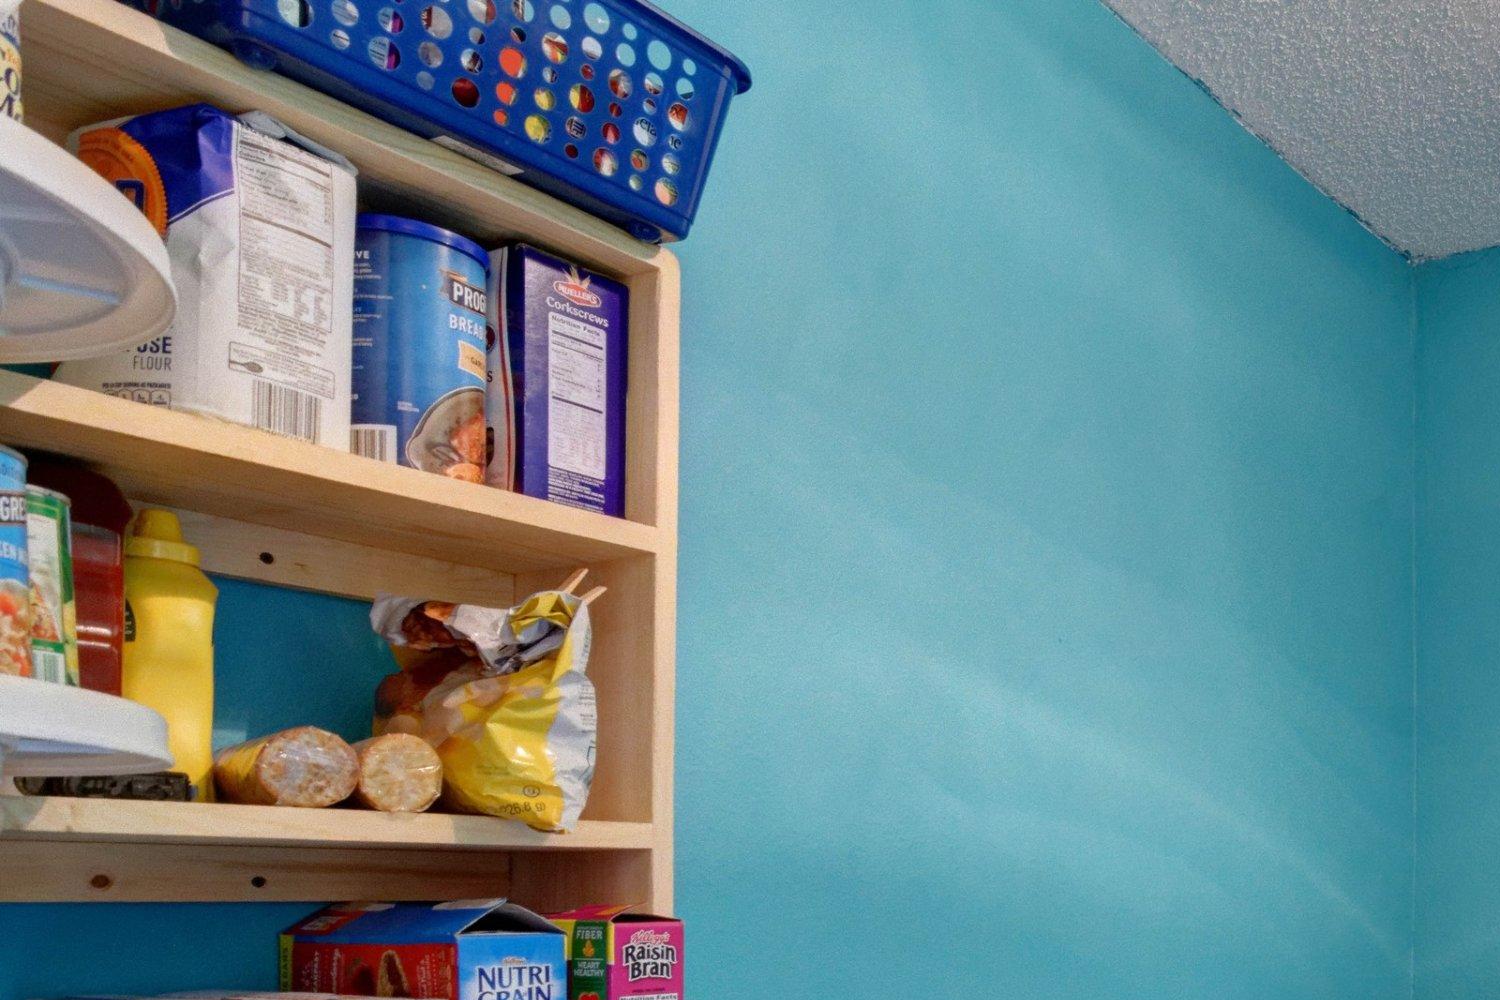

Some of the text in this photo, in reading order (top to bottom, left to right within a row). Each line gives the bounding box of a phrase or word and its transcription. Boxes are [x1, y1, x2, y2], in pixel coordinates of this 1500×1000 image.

[546, 296, 610, 328] Corkscrews
[132, 355, 172, 372] FLOUR
[576, 929, 604, 940] FIBER
[623, 944, 678, 966] Raisin
[573, 969, 605, 978] HEALTHY
[577, 961, 601, 969] HEART
[629, 961, 673, 981] Bran
[478, 965, 551, 993] NUTRI
